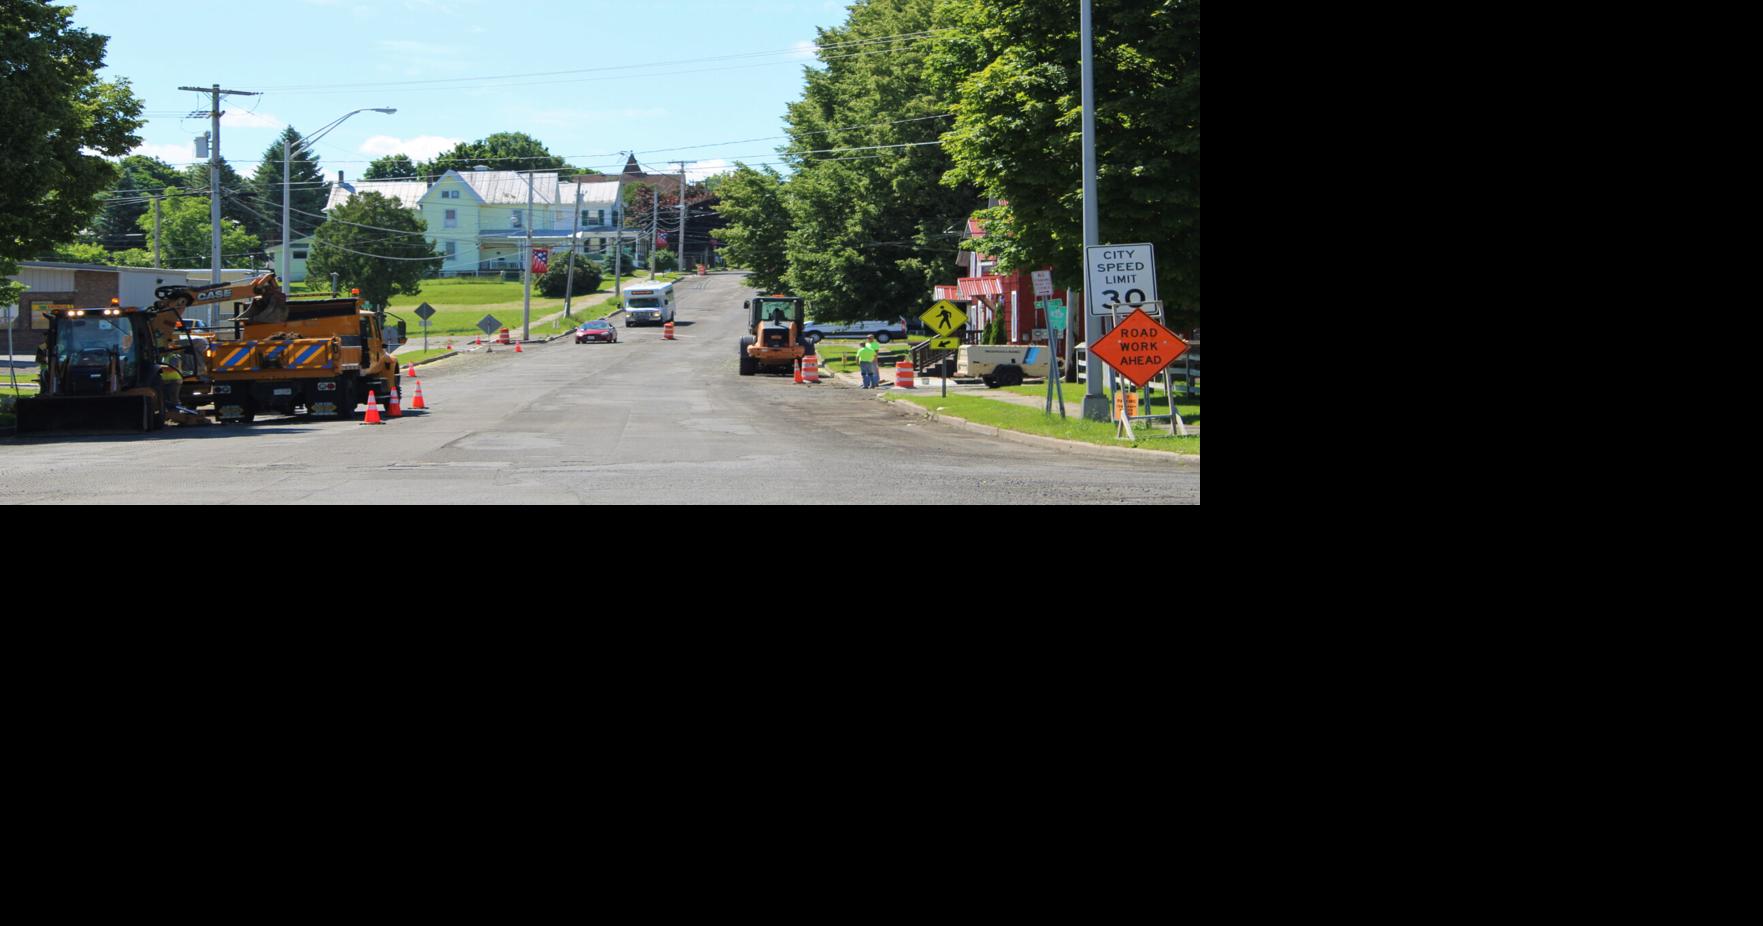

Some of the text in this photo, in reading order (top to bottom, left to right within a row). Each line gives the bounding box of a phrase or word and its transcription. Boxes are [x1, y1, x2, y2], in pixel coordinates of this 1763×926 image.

[1103, 250, 1135, 260] CITY
[1097, 262, 1145, 272] SPEED
[1105, 274, 1136, 285] LIMIT
[197, 288, 232, 301] CASE
[1101, 288, 1146, 310] 30
[1120, 328, 1158, 338] ROAD
[1120, 342, 1158, 352] WORK
[1120, 355, 1162, 366] AHEAD
